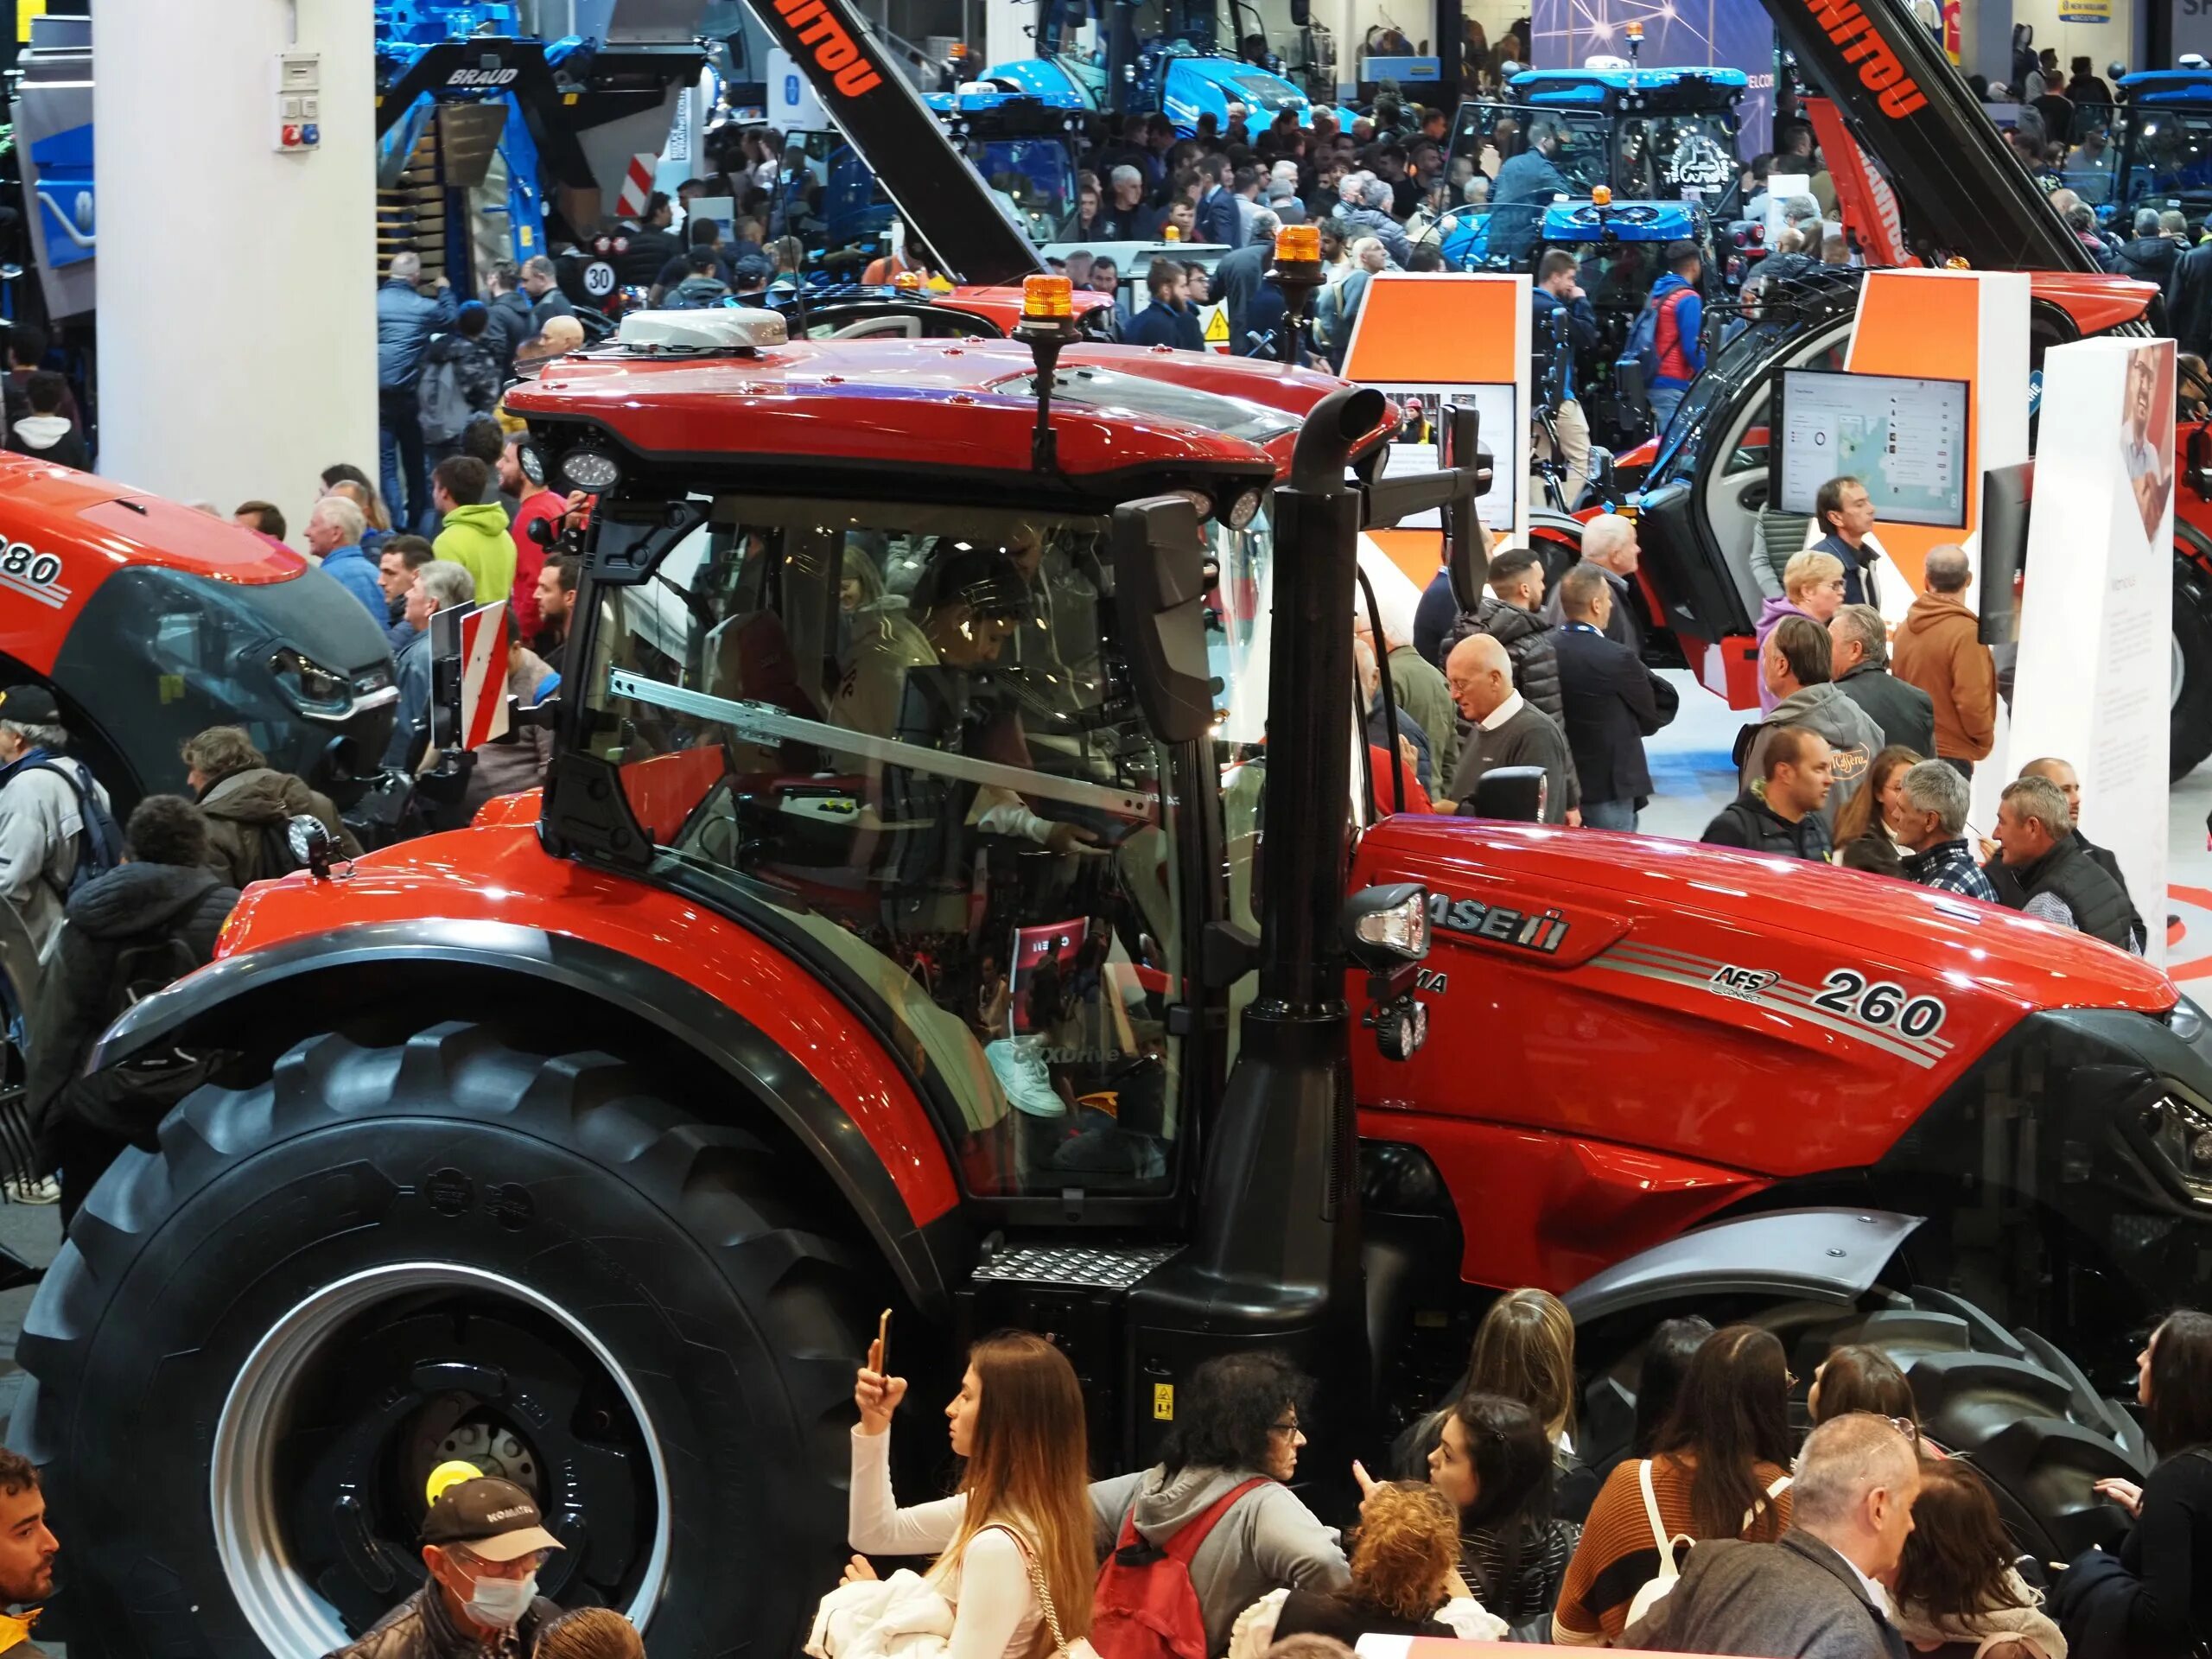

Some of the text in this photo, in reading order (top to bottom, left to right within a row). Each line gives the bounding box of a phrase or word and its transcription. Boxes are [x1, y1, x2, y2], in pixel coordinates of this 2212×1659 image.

[447, 69, 518, 85] BRAUD
[589, 269, 609, 289] 30
[1714, 966, 1764, 991] AFS
[1722, 988, 1761, 1004] CONNECT
[1812, 969, 1945, 1039] 260
